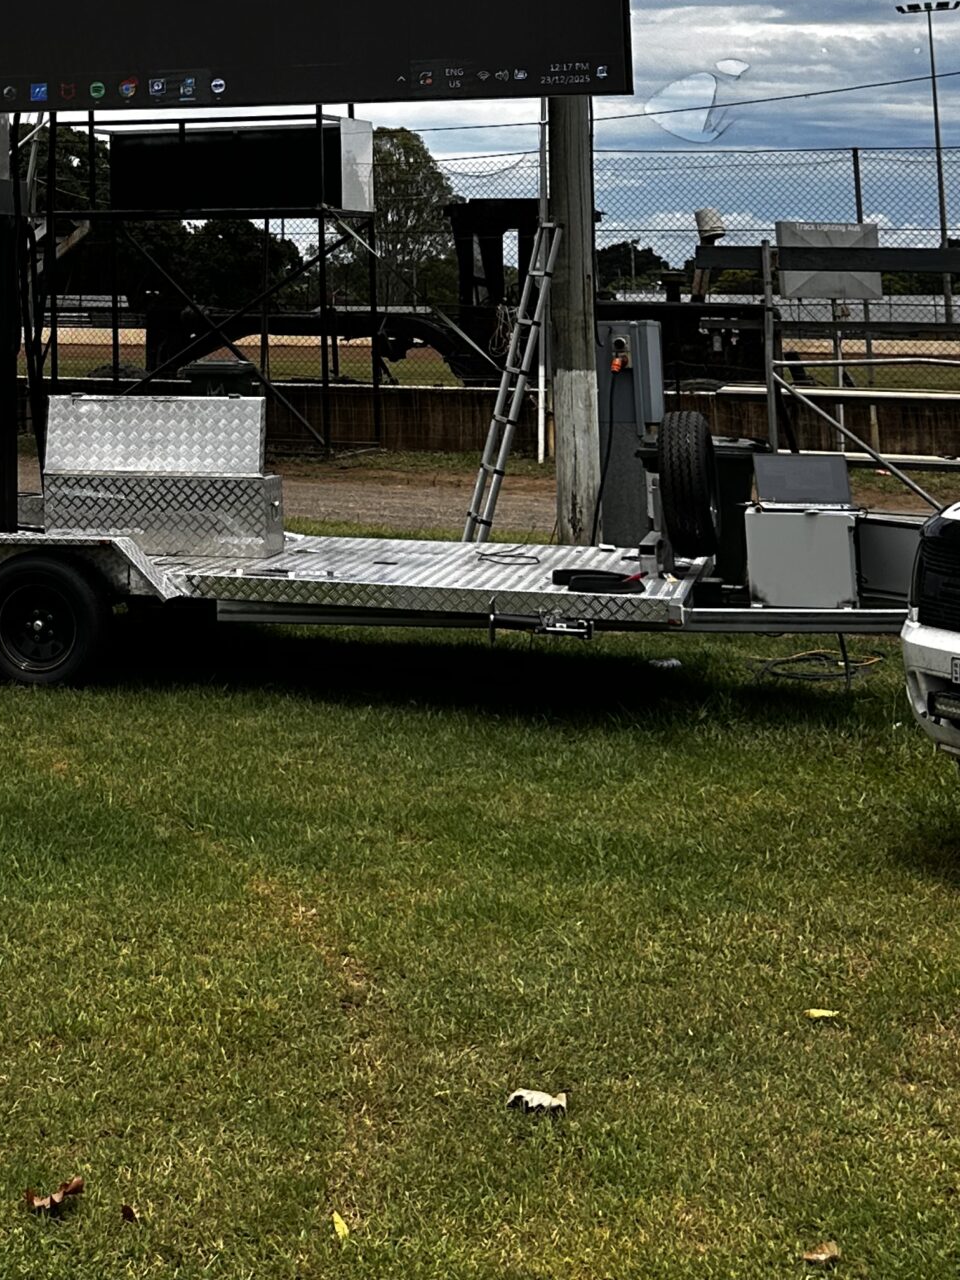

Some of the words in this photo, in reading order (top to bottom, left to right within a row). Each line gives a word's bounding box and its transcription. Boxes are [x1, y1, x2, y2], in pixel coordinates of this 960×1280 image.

[445, 68, 464, 76] ENG
[550, 64, 573, 72] 12:17
[449, 80, 461, 88] US
[796, 223, 816, 232] Track
[817, 223, 846, 234] Lighting
